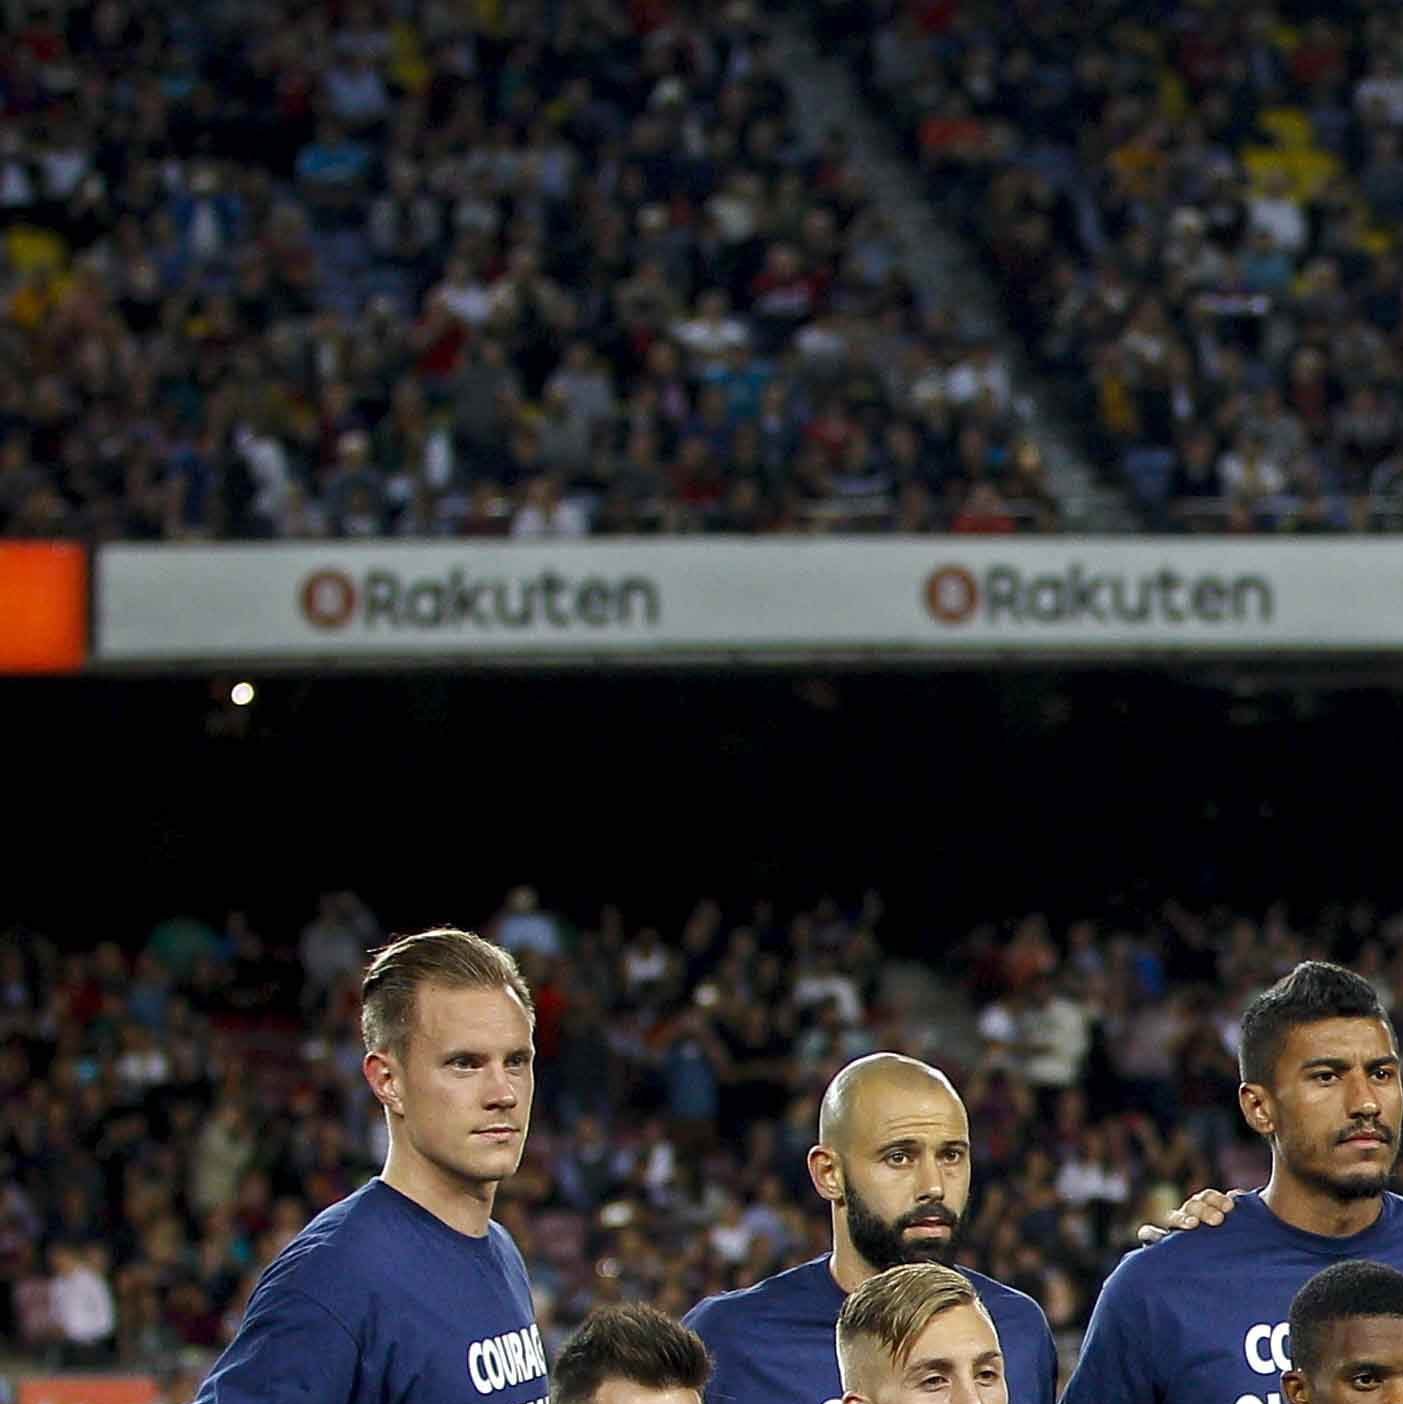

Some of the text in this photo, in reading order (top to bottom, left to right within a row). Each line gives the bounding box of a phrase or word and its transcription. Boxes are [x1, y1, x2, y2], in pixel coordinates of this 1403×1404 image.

[365, 570, 660, 629] Rakuten
[985, 566, 1274, 624] Rakuten
[468, 1323, 547, 1394] COURAG
